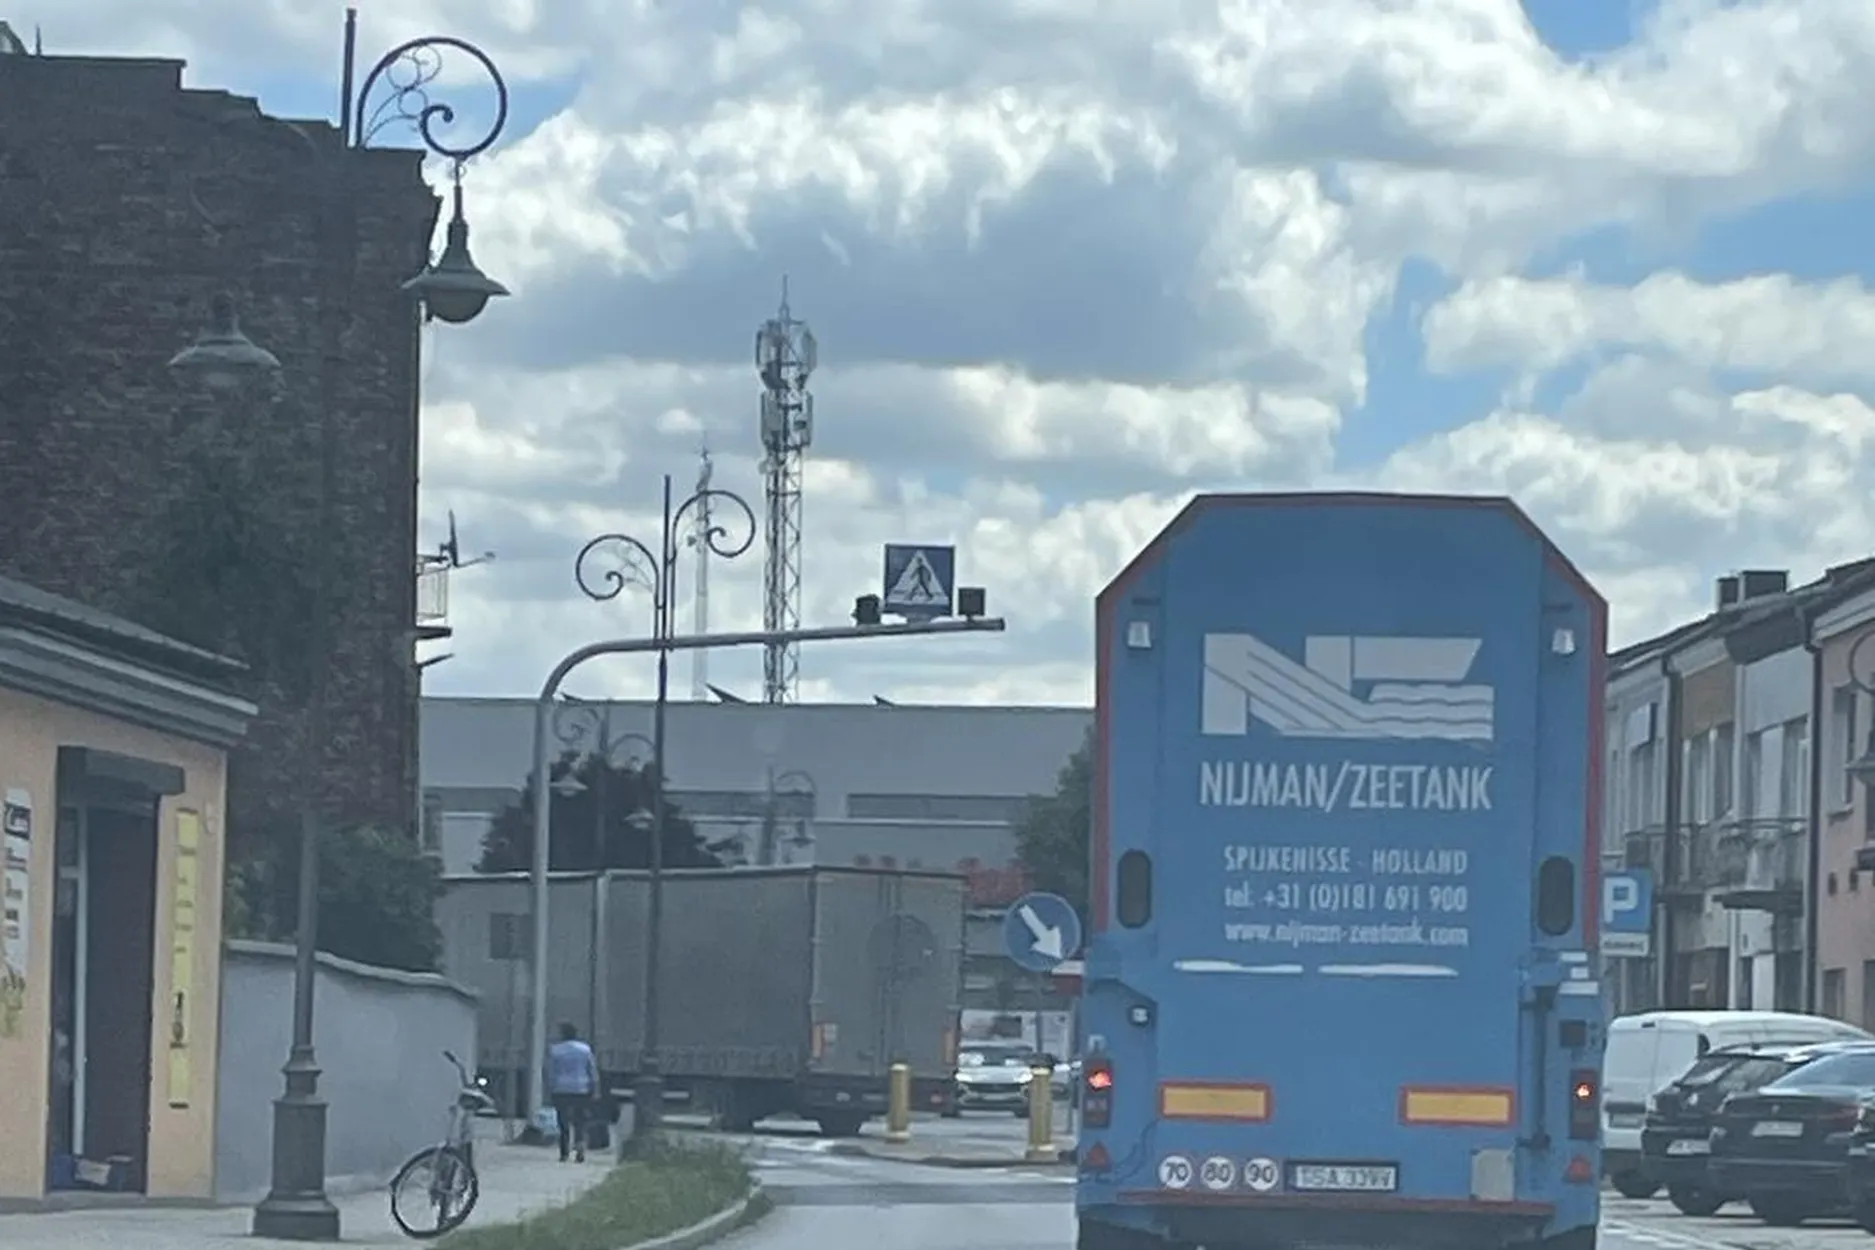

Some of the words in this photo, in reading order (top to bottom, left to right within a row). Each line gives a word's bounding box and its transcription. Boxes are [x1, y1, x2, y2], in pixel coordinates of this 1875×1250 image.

[1200, 760, 1494, 813] NIJMAN/ZEETANK
[1223, 844, 1350, 873] SPIJKENISSE
[1372, 848, 1468, 875] HOLLAND
[1263, 883, 1299, 909] +31
[1384, 885, 1420, 911] 691
[1429, 885, 1468, 912] 900
[1602, 876, 1639, 924] P
[1166, 1162, 1189, 1180] 70
[1204, 1162, 1229, 1182] 80
[1250, 1163, 1275, 1183] 90
